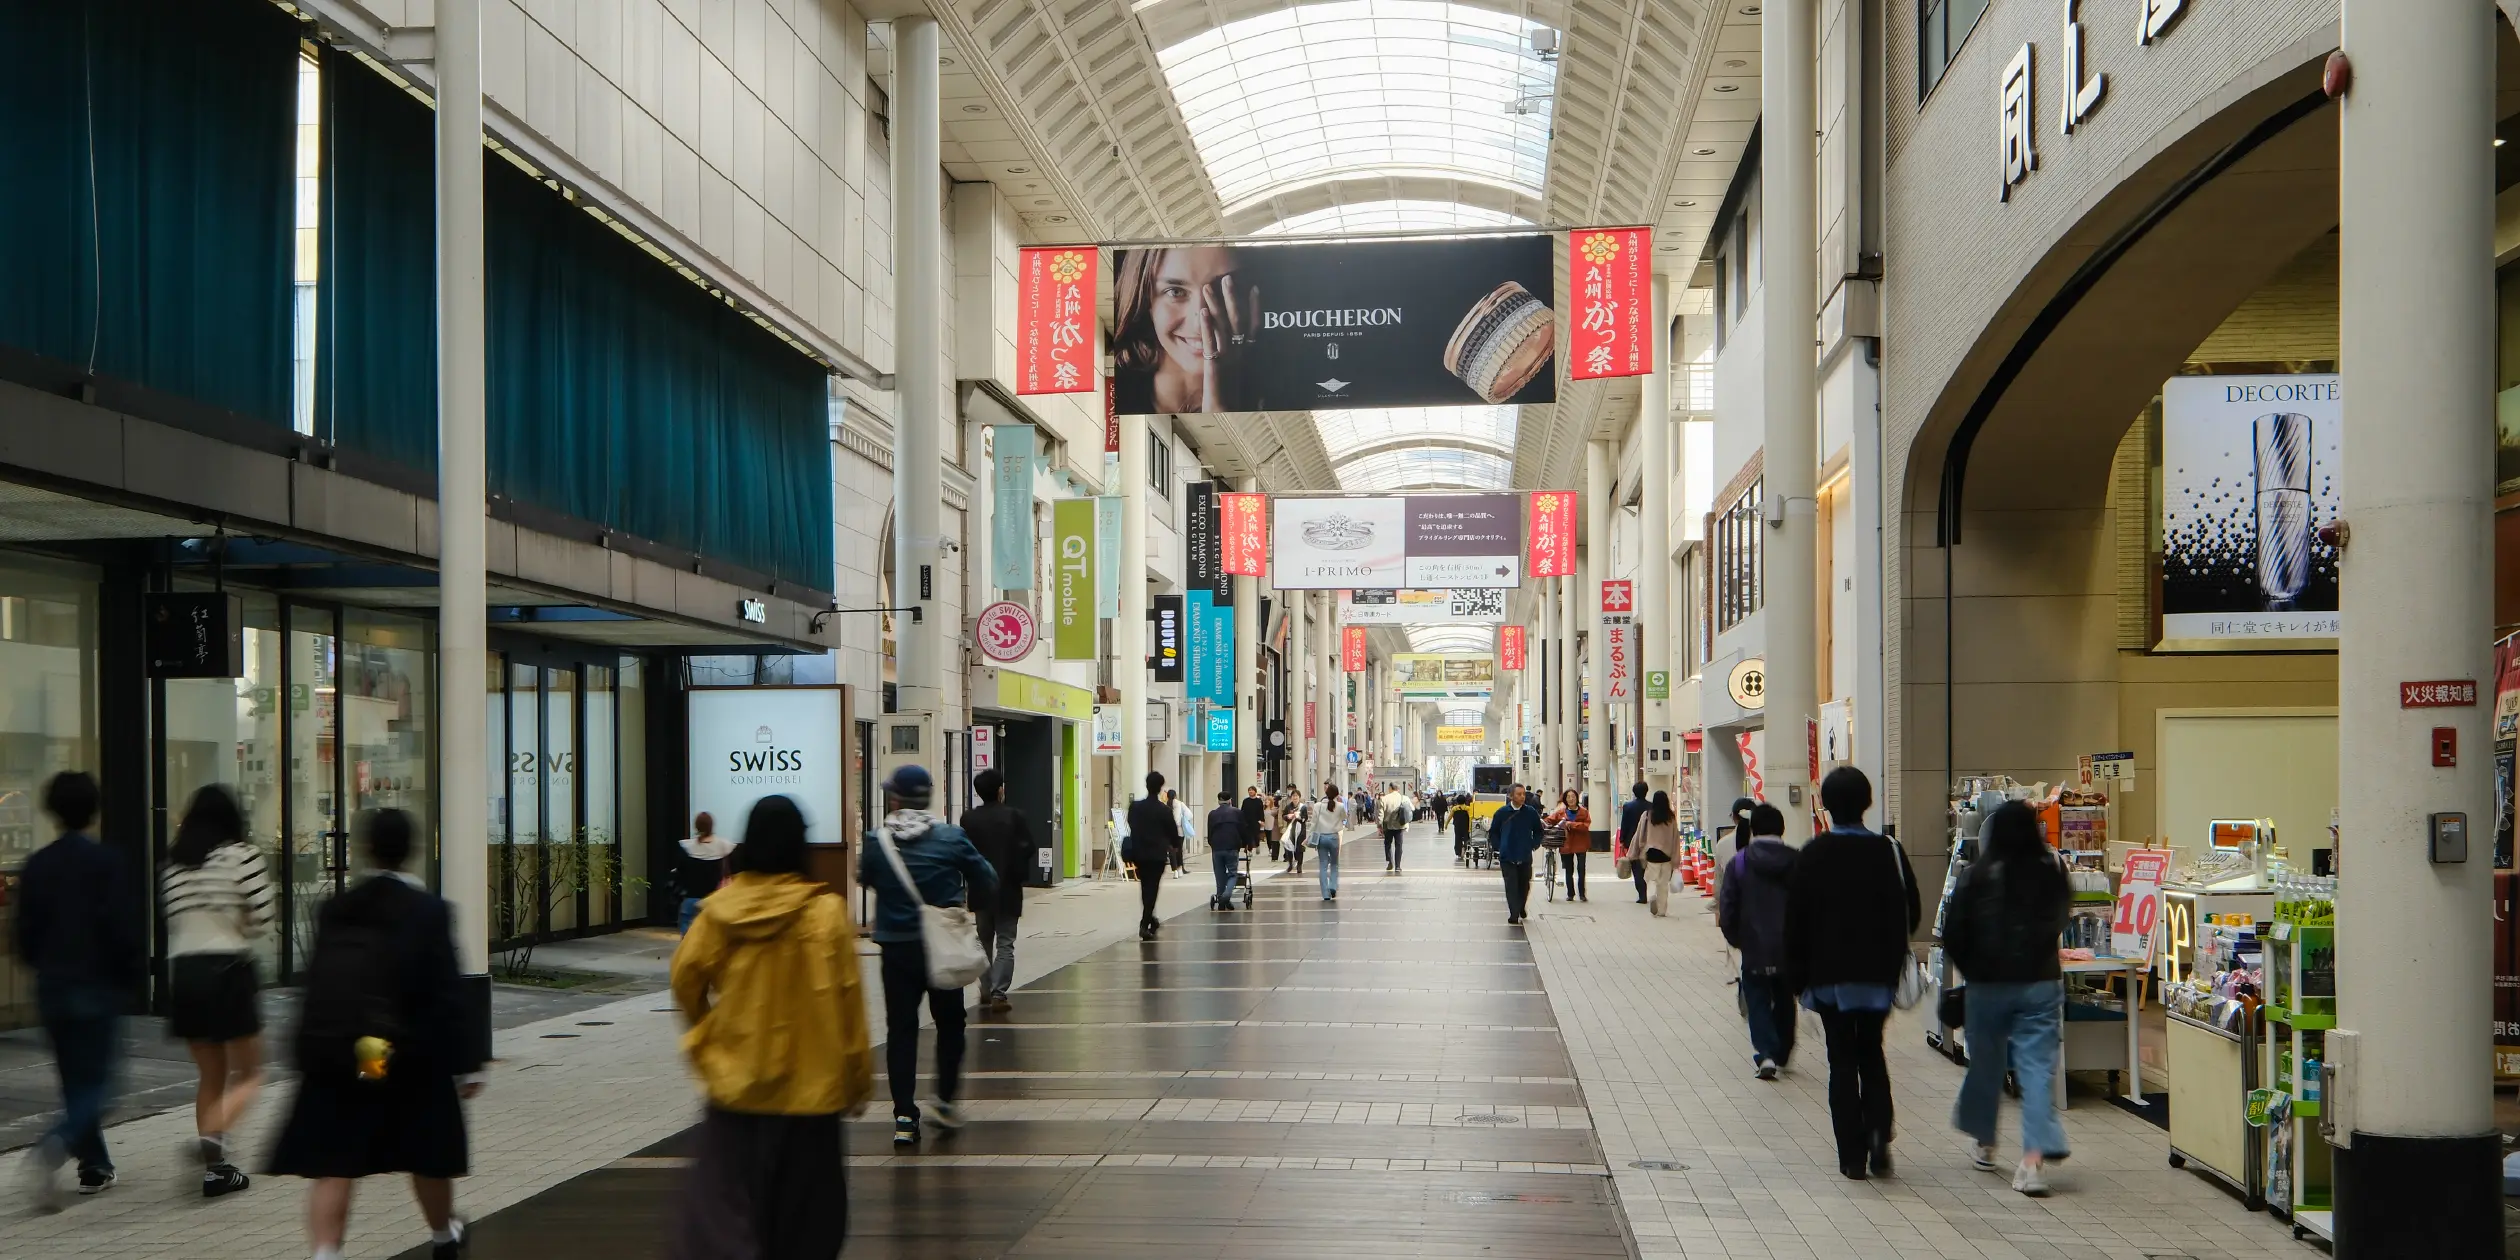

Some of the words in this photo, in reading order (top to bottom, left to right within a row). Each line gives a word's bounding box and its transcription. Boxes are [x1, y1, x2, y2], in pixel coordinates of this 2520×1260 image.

[1264, 308, 1402, 329] BOUCHERON
[1581, 266, 1618, 375] 九州がっ祭
[2226, 380, 2339, 403] DECORTÉ
[1198, 495, 1206, 530] EXELCO
[1198, 532, 1206, 578] DIAMOND
[1536, 513, 1557, 575] 九州がっ祭
[1305, 566, 1372, 576] I-PRIMO
[1604, 583, 1630, 609] 本
[982, 611, 997, 627] Cafe
[999, 606, 1028, 626] SWITCH
[1193, 602, 1201, 643] DIAMOND
[1161, 610, 1176, 667] DOUTOR
[1609, 627, 1627, 697] まるぶん
[2405, 684, 2475, 703] 火災報知機
[731, 775, 801, 785] KONDITOREI
[2114, 892, 2156, 936] 10
